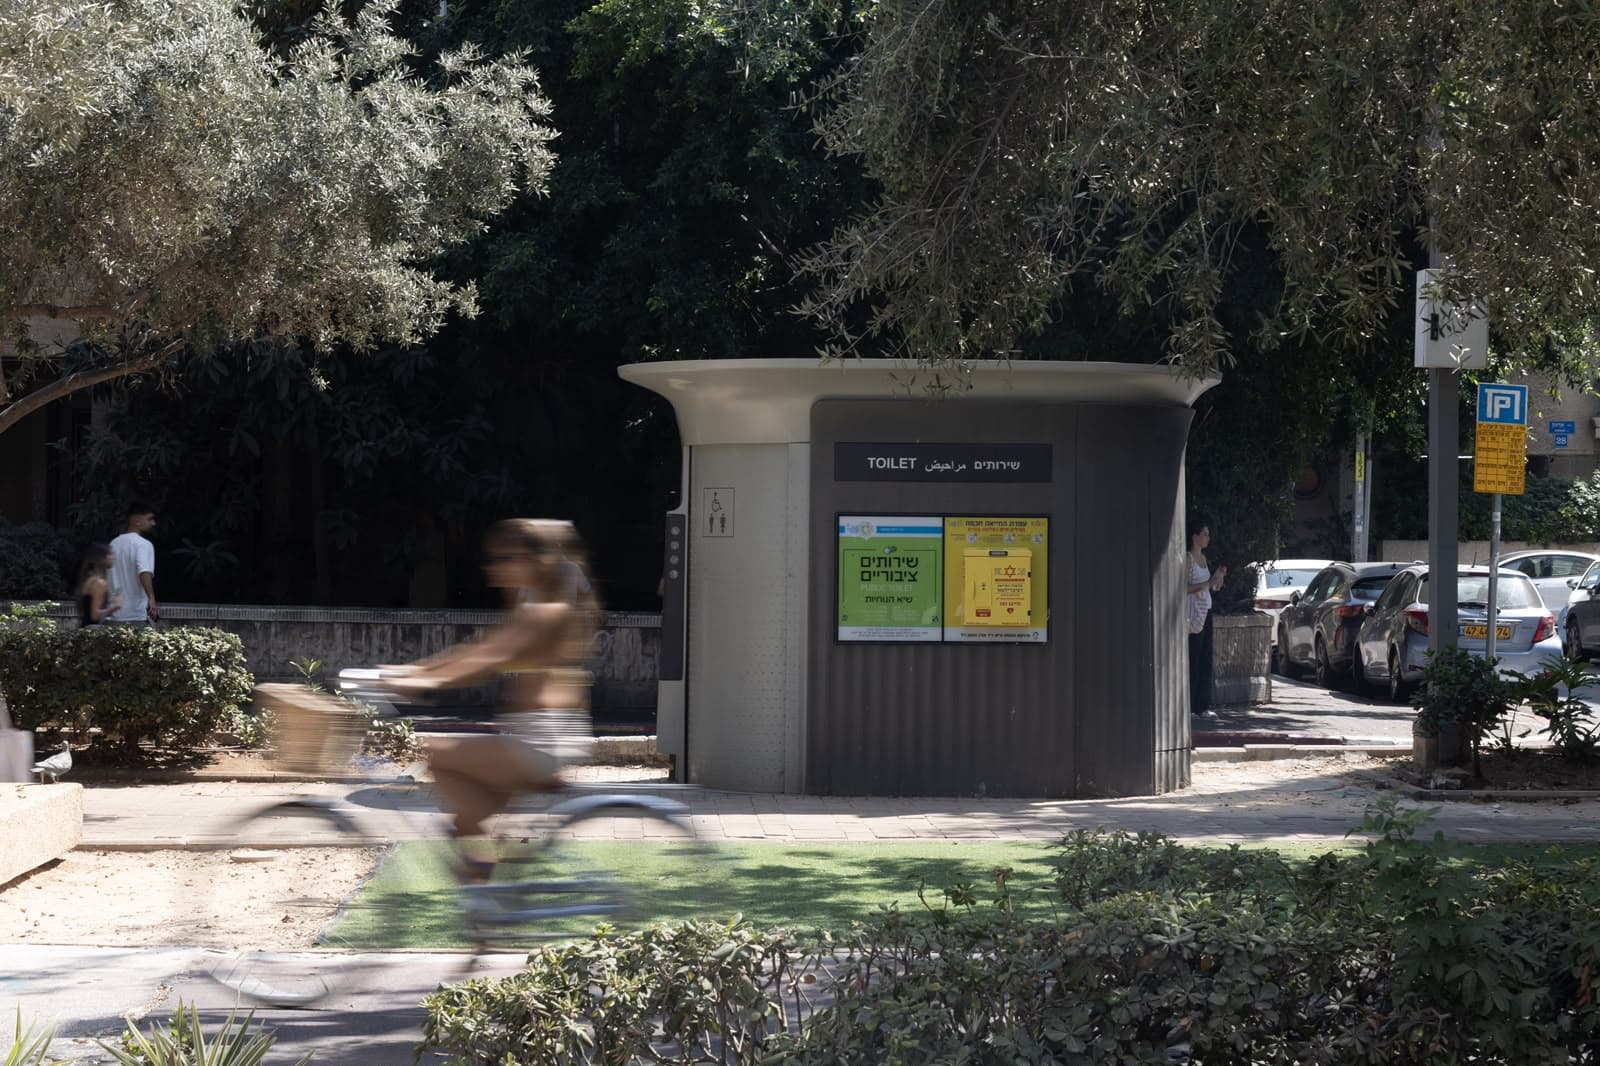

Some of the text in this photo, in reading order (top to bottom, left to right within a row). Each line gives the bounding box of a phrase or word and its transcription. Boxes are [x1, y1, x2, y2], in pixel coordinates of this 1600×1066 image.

[1556, 437, 1567, 445] 28
[867, 457, 917, 469] TOILET
[924, 460, 967, 472] مراحيض
[974, 461, 1021, 470] שירותים
[860, 556, 919, 569] שירותים
[860, 570, 918, 583] ציבוריים
[897, 596, 913, 604] שיא
